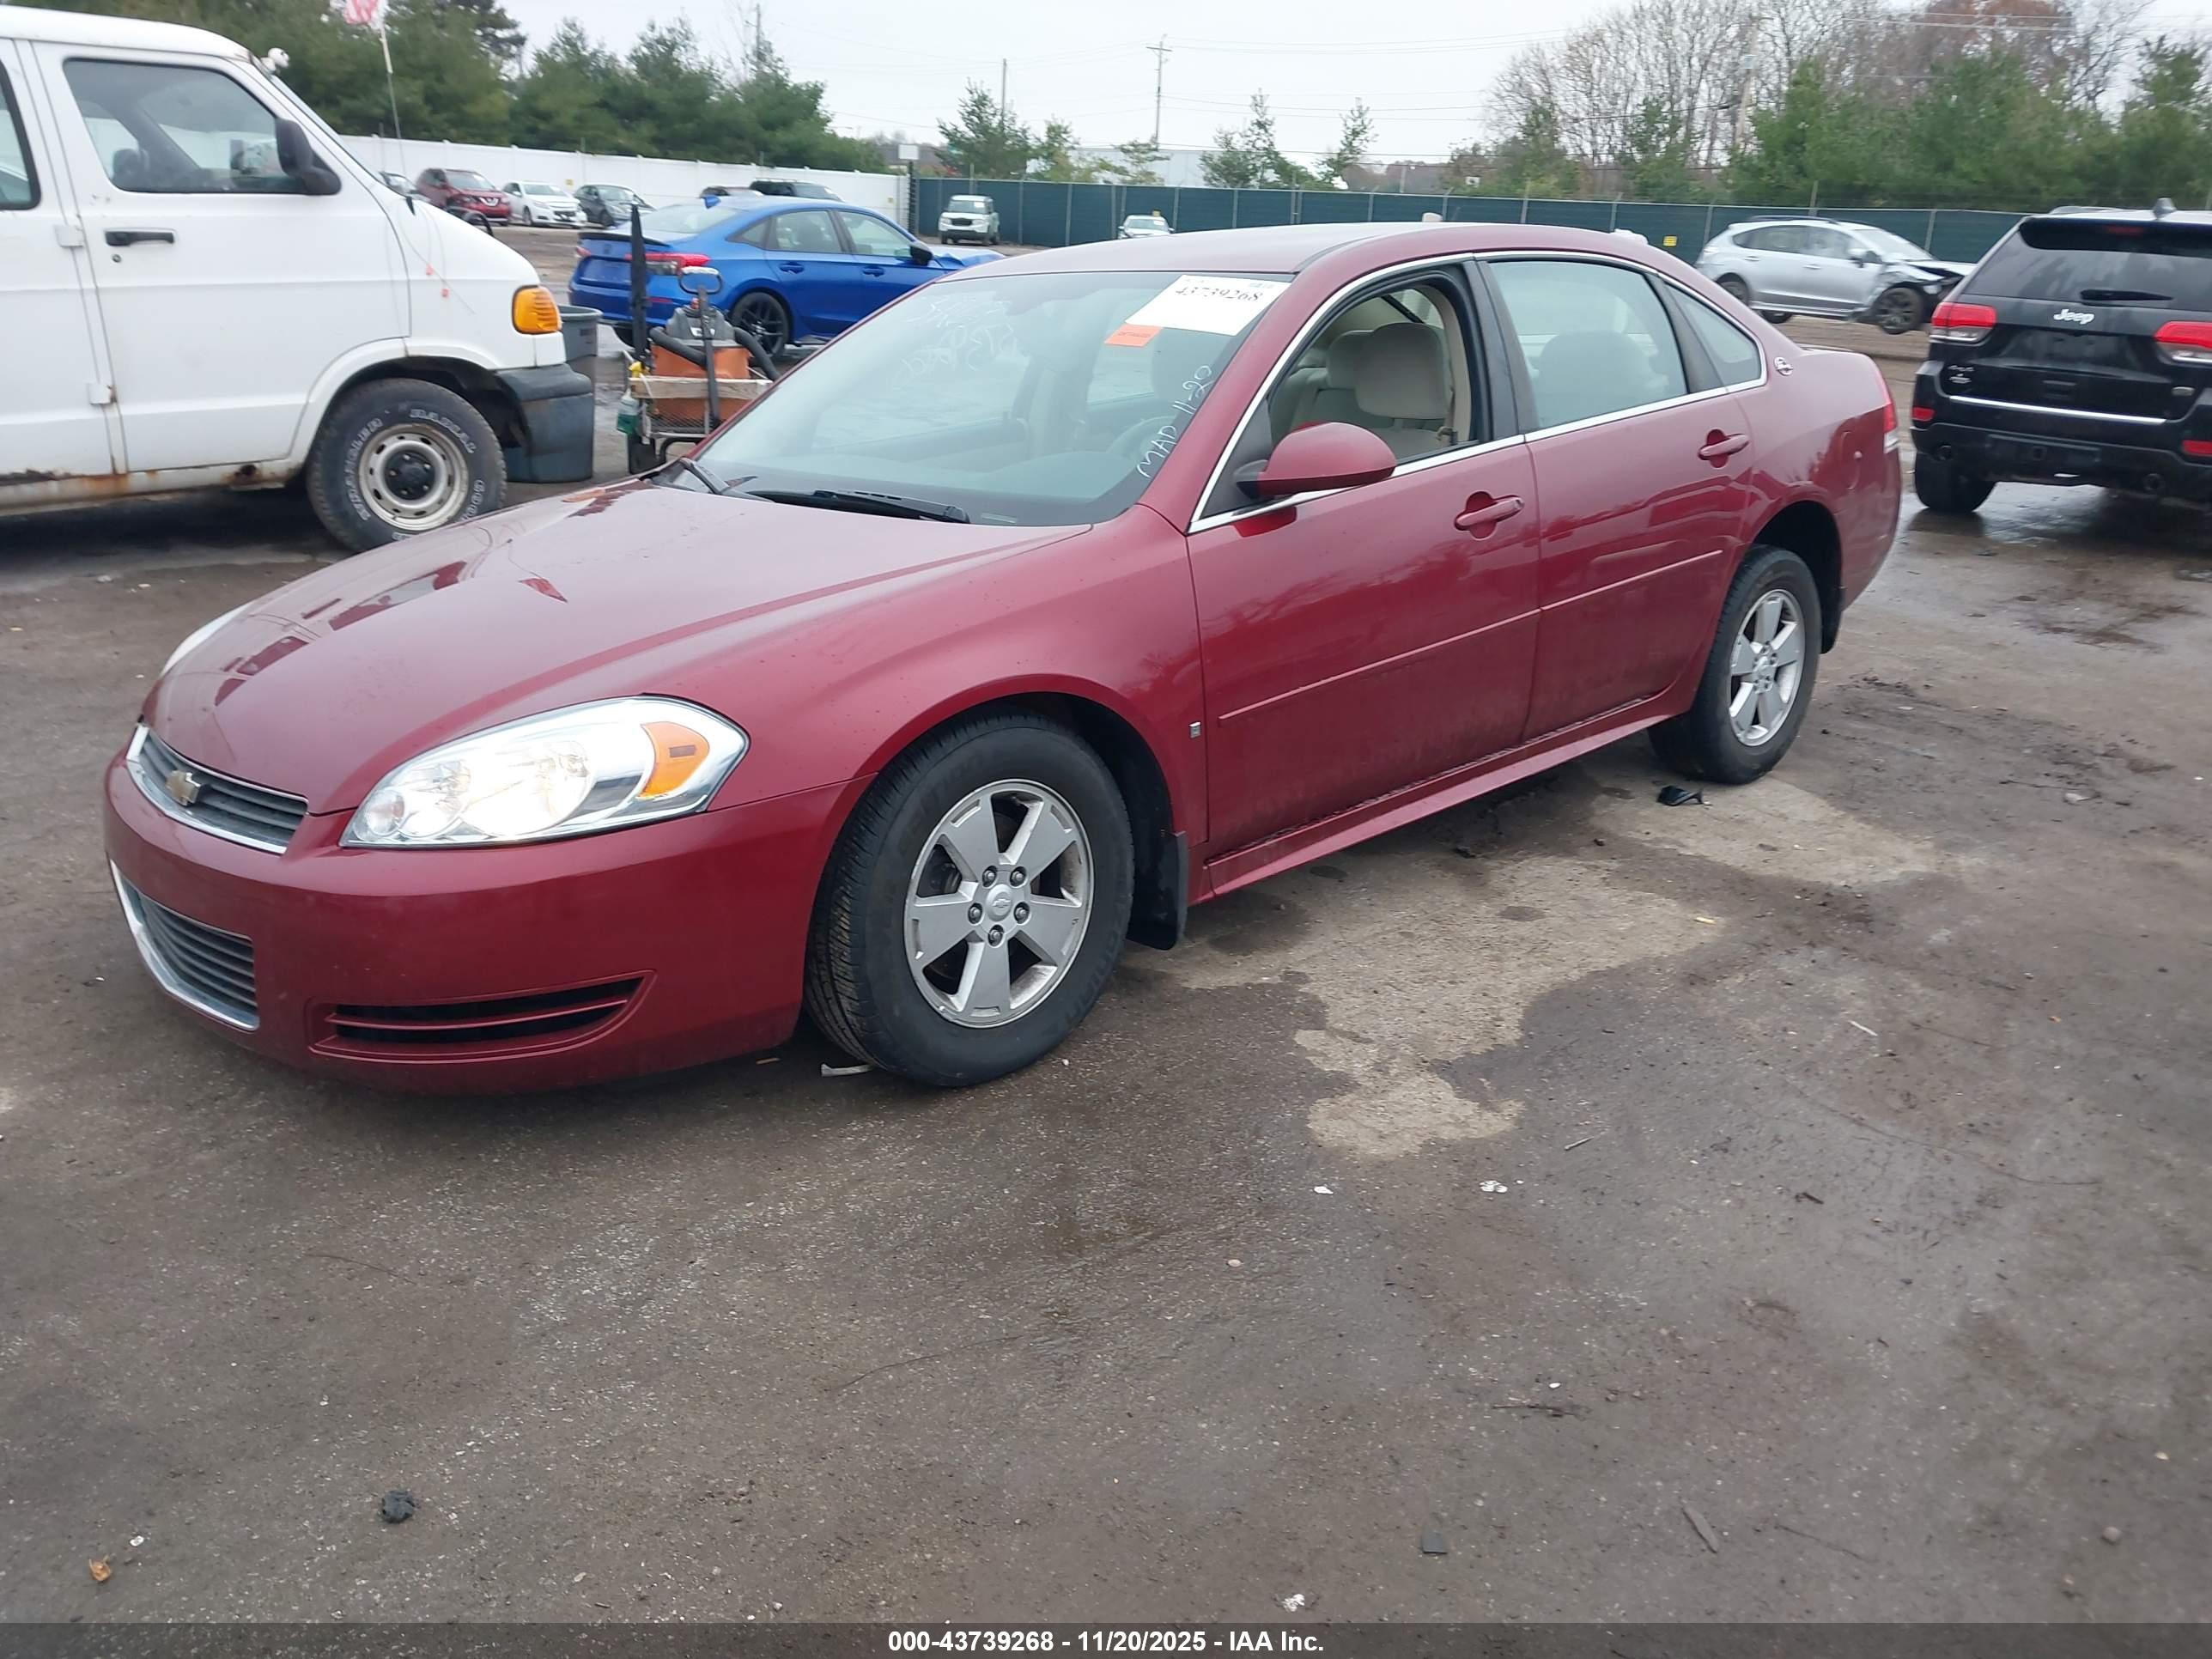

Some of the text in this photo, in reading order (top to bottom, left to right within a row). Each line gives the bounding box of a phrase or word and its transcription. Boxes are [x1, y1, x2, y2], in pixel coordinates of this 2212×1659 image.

[1176, 287, 1263, 301] 43739268
[2053, 309, 2095, 325] Jeep
[410, 409, 477, 453] RADIAL
